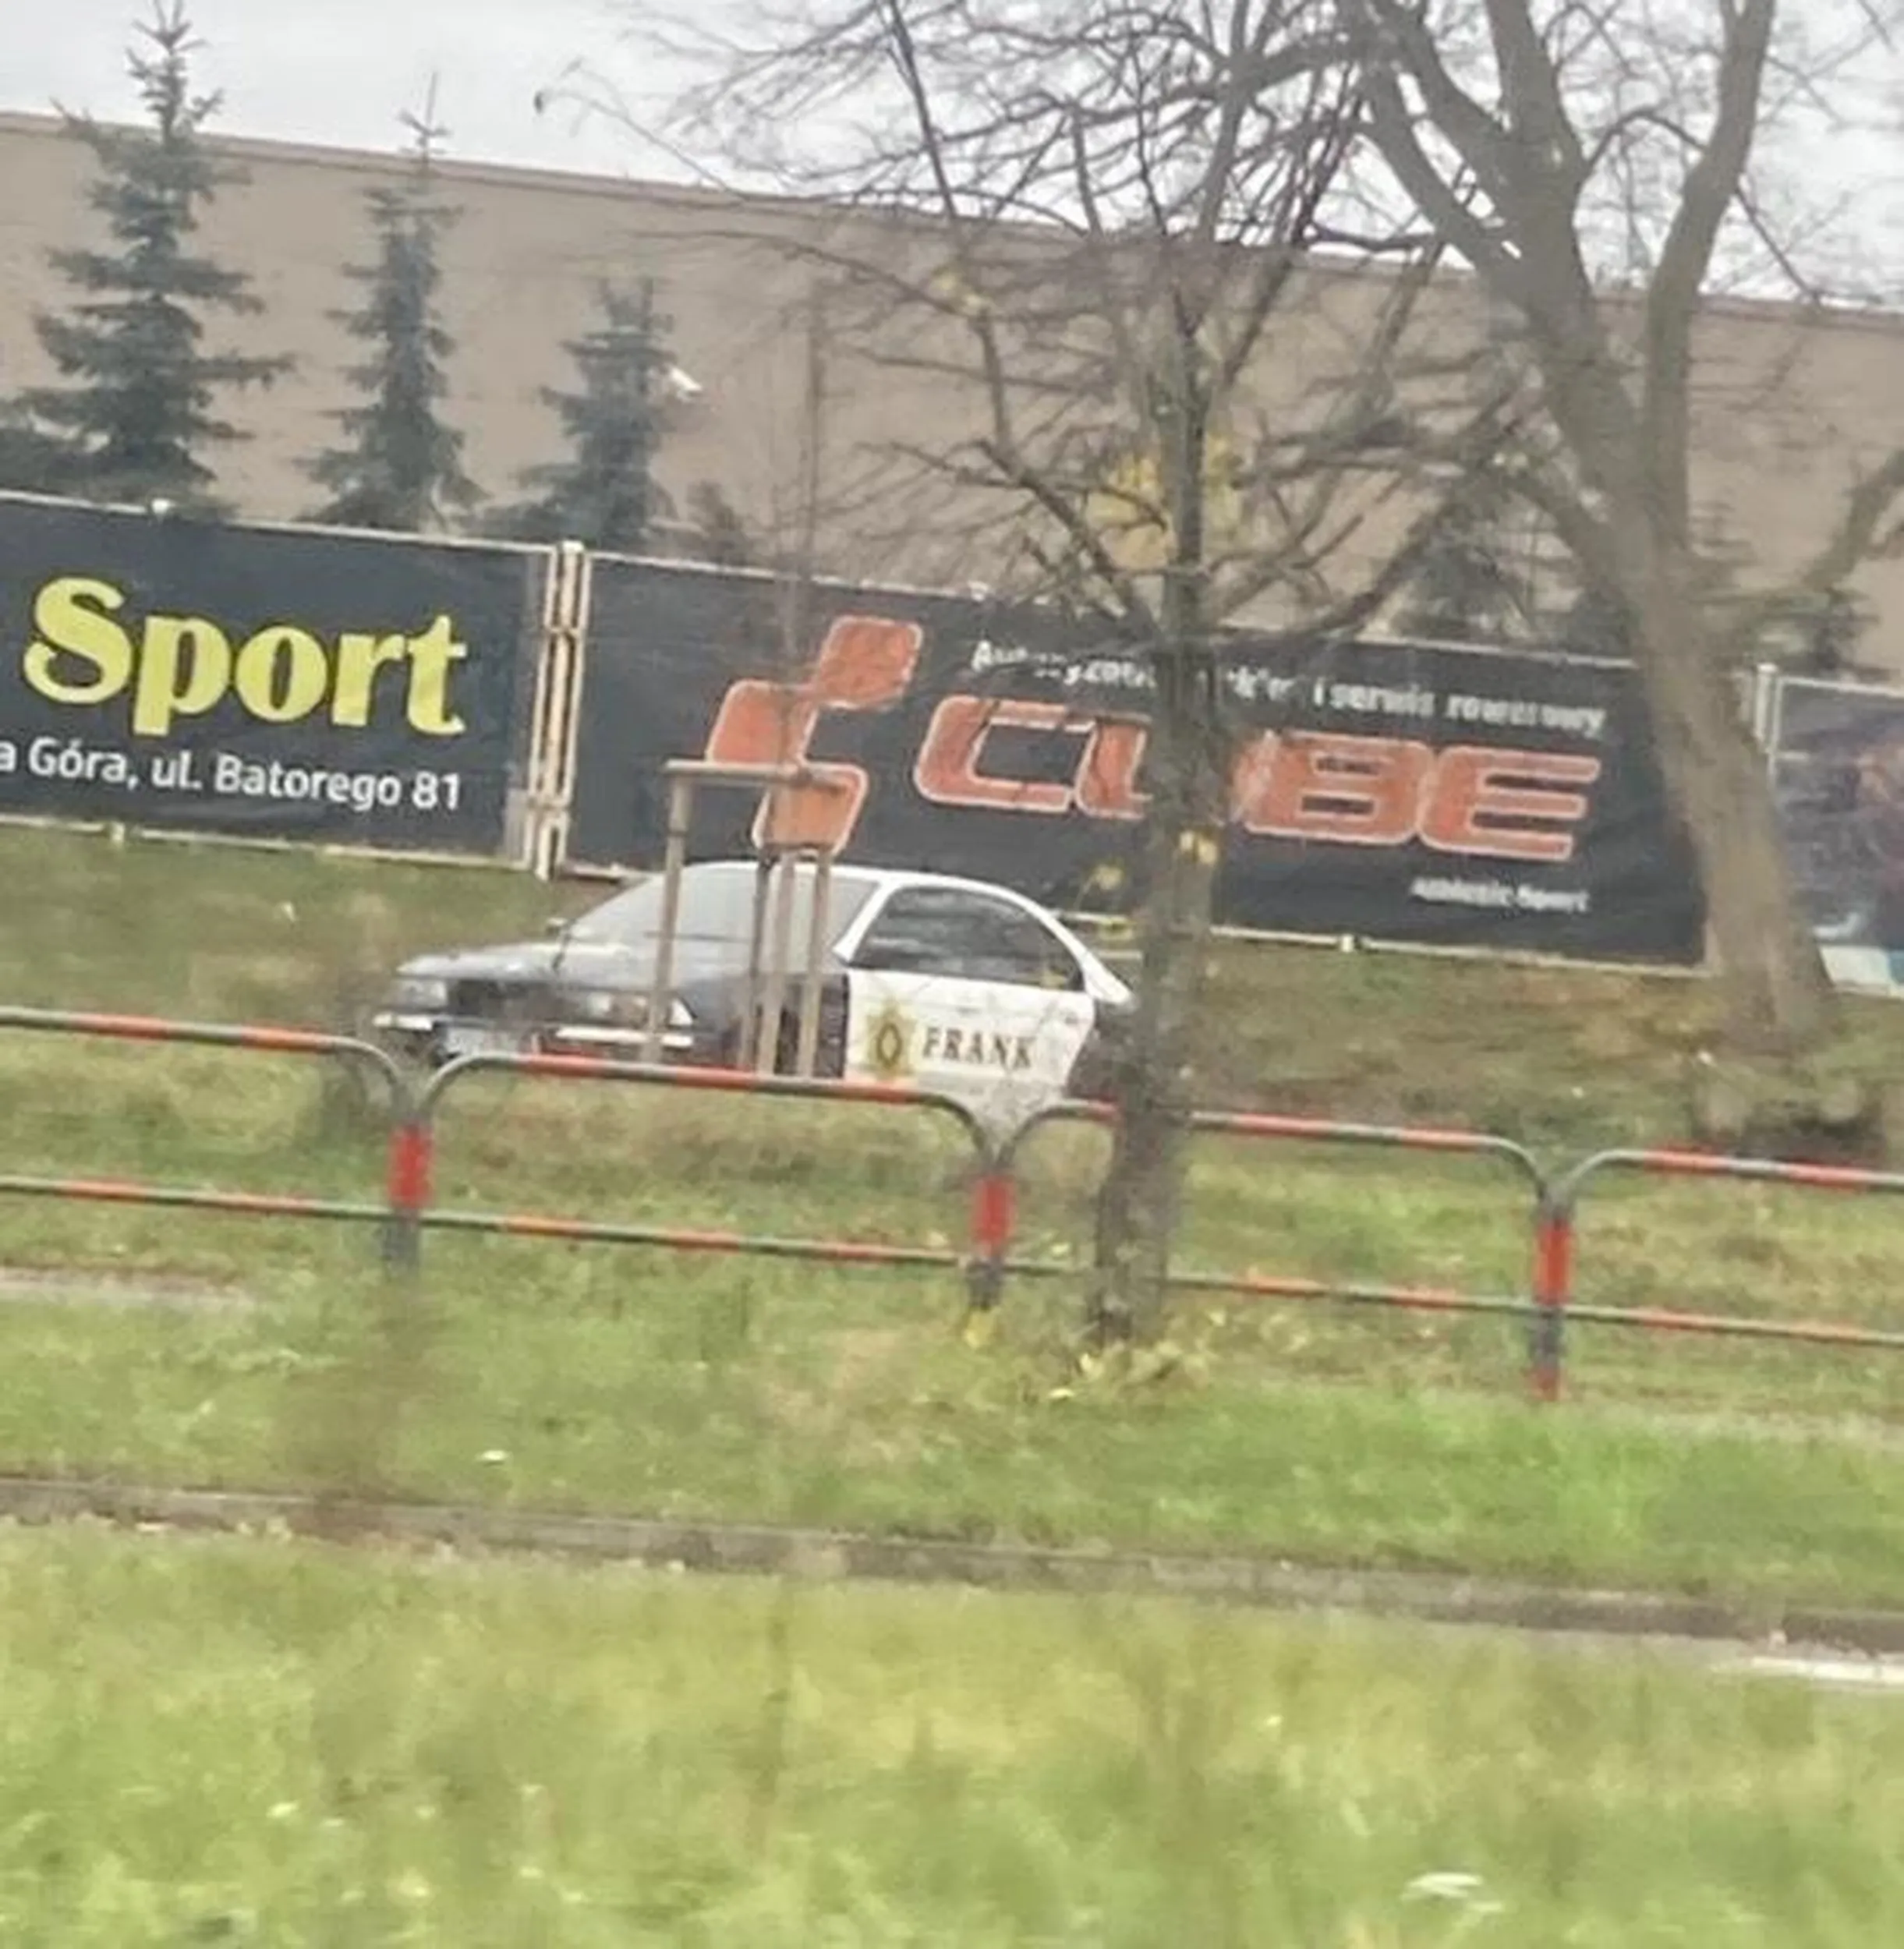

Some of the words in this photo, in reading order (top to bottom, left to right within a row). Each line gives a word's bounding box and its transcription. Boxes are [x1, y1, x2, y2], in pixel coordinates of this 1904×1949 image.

[23, 577, 467, 736] Sport
[28, 736, 140, 790] Góra,
[151, 749, 202, 790] ul.
[214, 752, 402, 812] Batorego
[411, 771, 461, 811] 81
[922, 1026, 1037, 1068] FRANK
